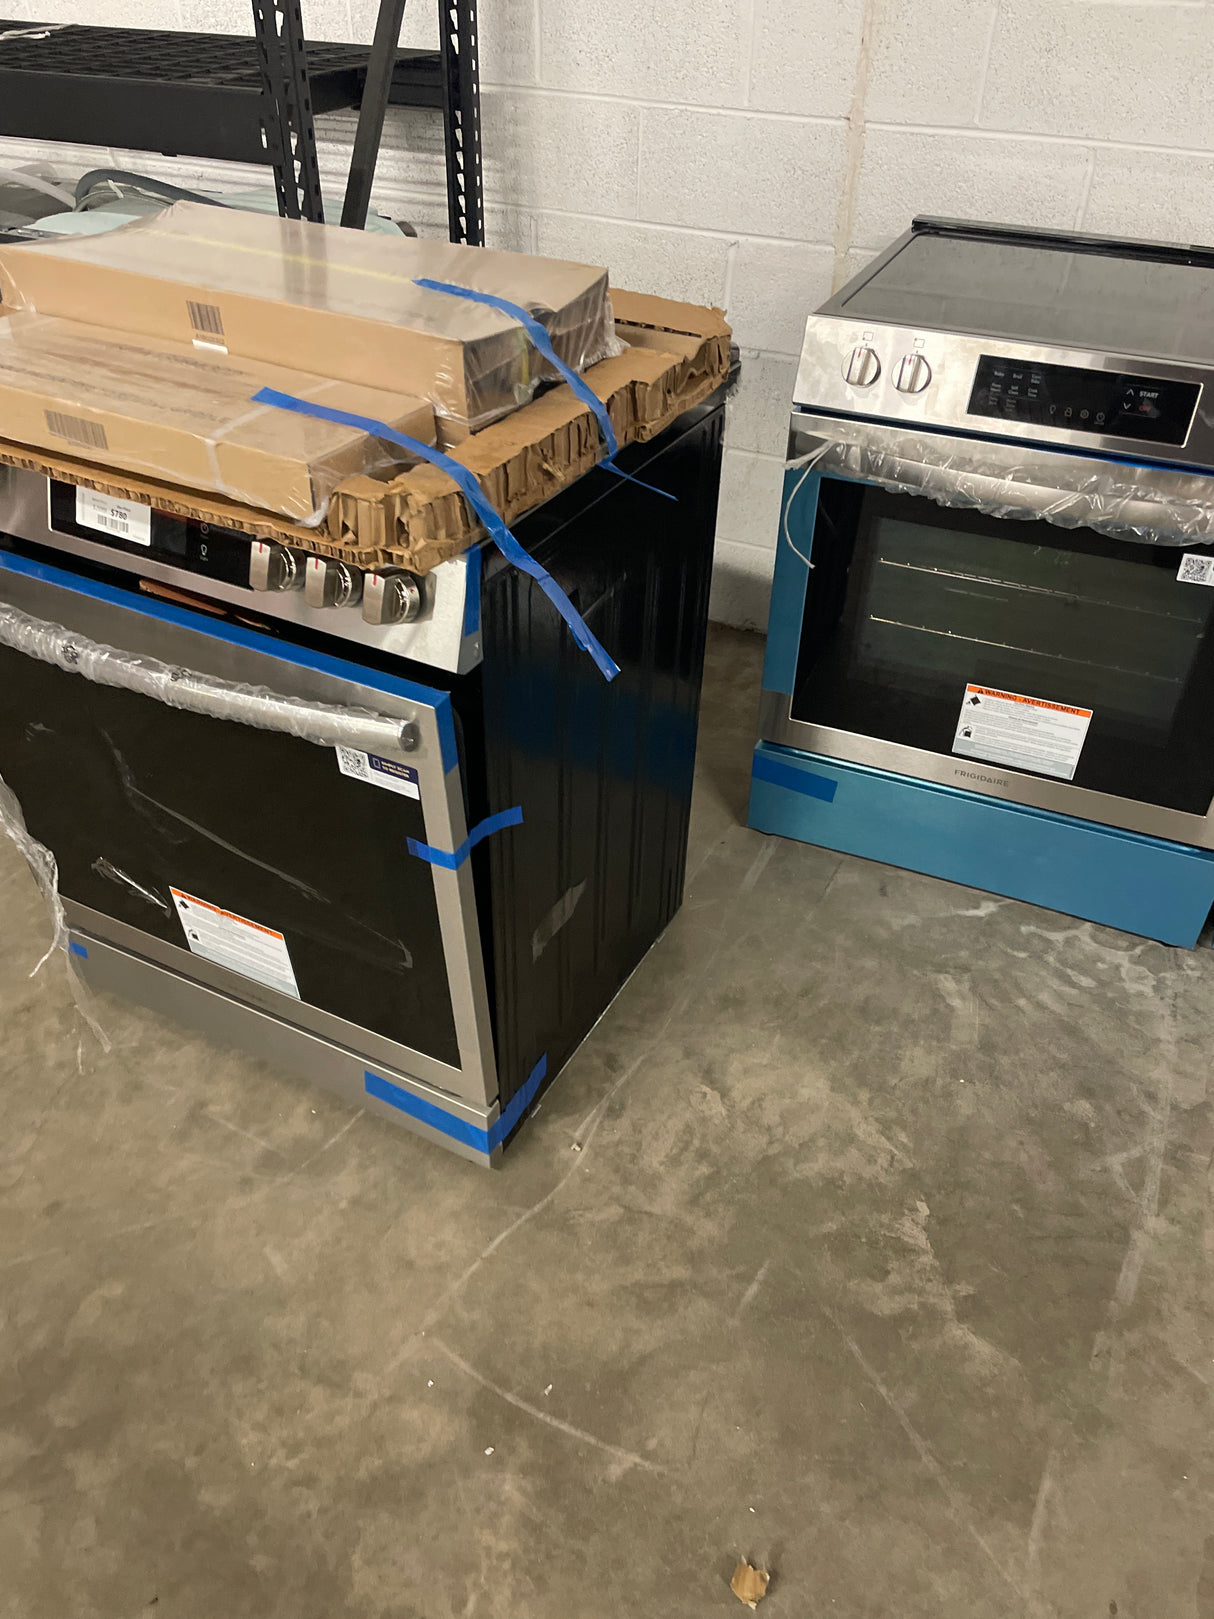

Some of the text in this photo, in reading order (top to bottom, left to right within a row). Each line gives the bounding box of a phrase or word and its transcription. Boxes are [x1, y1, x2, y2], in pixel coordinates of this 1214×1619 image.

[1139, 390, 1159, 399] START
[110, 508, 128, 521] $780
[983, 688, 1017, 701] WARNING
[1022, 694, 1081, 716] AVERTISSEMENT
[954, 769, 1009, 788] FRIGIDAIRE
